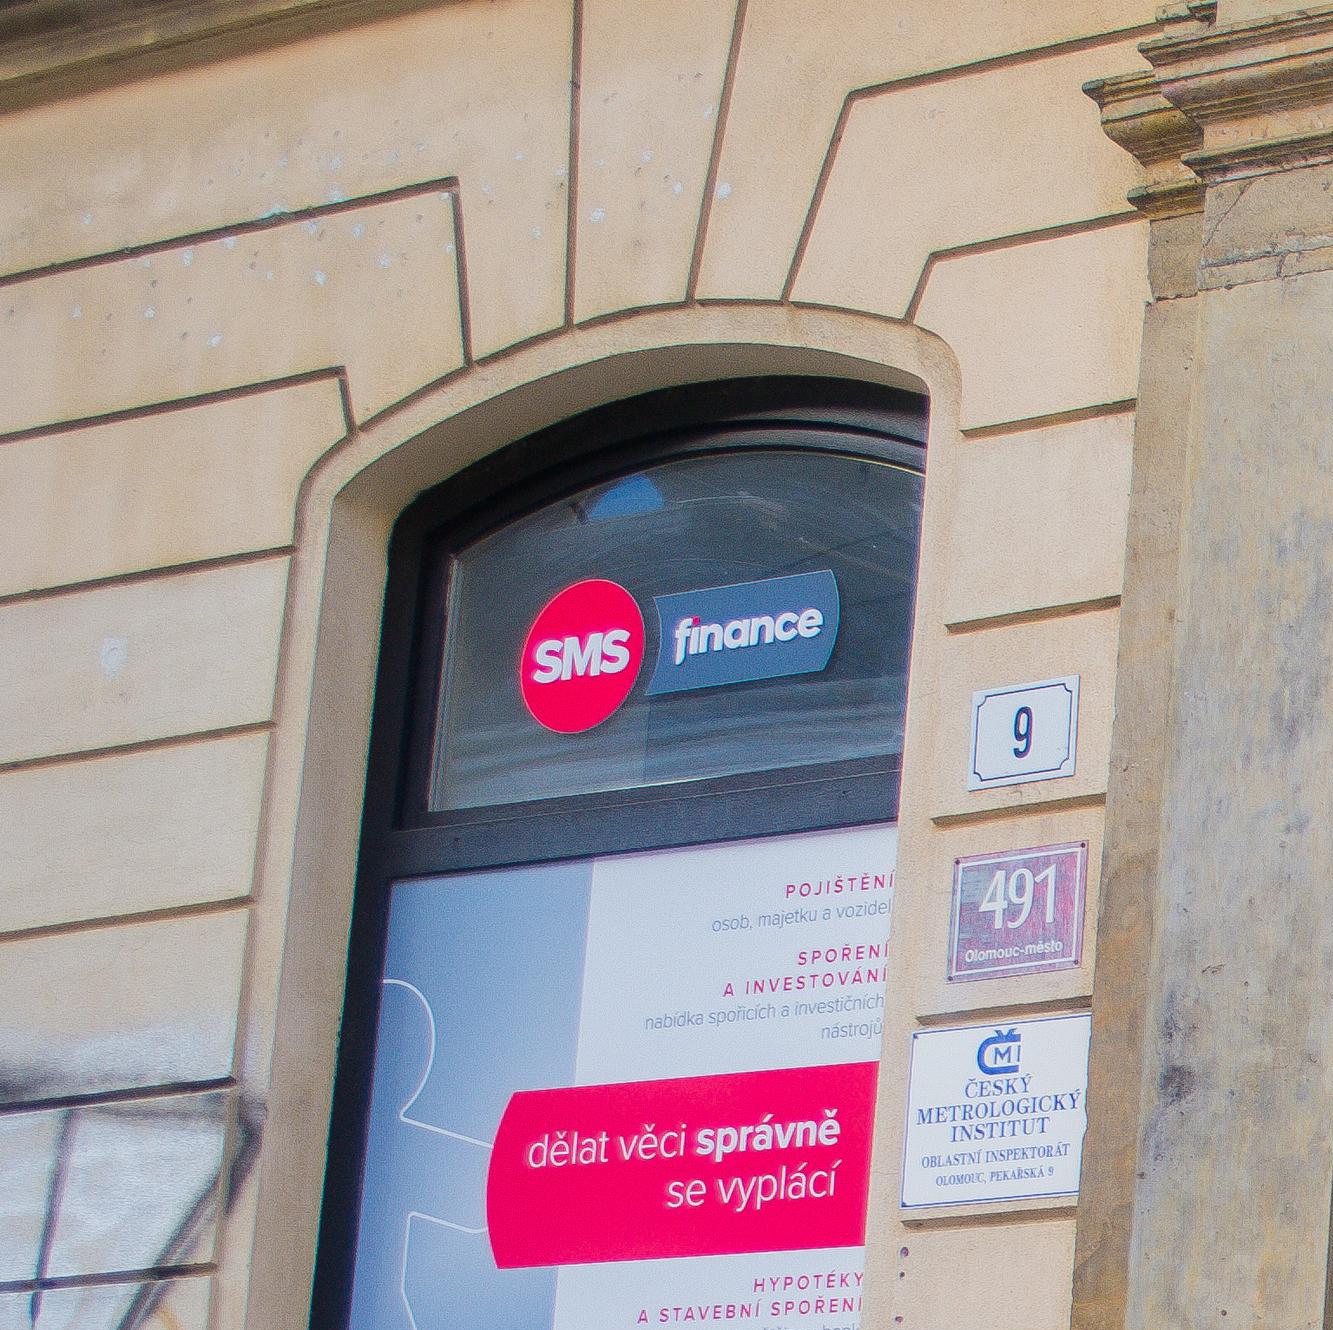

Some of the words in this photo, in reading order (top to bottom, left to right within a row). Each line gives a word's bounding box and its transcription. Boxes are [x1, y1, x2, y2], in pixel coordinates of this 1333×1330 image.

[533, 629, 631, 684] SMS
[674, 608, 824, 665] finance
[1013, 706, 1033, 759] 9
[785, 870, 896, 898] POJIŠTĚNÍ
[979, 864, 1057, 929] 491
[712, 914, 753, 932] osob,
[758, 906, 818, 929] majetku
[822, 909, 832, 921] a
[836, 900, 891, 918] vozidel
[965, 939, 1064, 962] Olomouc-město
[723, 983, 734, 997] A
[645, 1010, 704, 1030] nabídka
[781, 1004, 790, 1017] a
[795, 993, 884, 1015] investičních
[821, 1017, 882, 1040] nástrojů
[965, 1074, 1033, 1098] ČESKÝ
[916, 1089, 1081, 1125] METROLOGICKÝ
[528, 1131, 609, 1168] dělat
[619, 1124, 687, 1160] věci
[696, 1108, 841, 1162] správně
[951, 1117, 1050, 1143] INSTITUT
[922, 1150, 981, 1169] OBLASTNÍ
[985, 1141, 1071, 1163] INSPEKTORÁT
[667, 1178, 706, 1207] se
[718, 1160, 842, 1212] vyplácí
[990, 1165, 1044, 1182] PEKAŘSKÁ
[1047, 1167, 1055, 1177] 9
[753, 1270, 864, 1293] HYPOTÉKY
[637, 1309, 649, 1324] A
[660, 1299, 761, 1322] STAVEBNÍ
